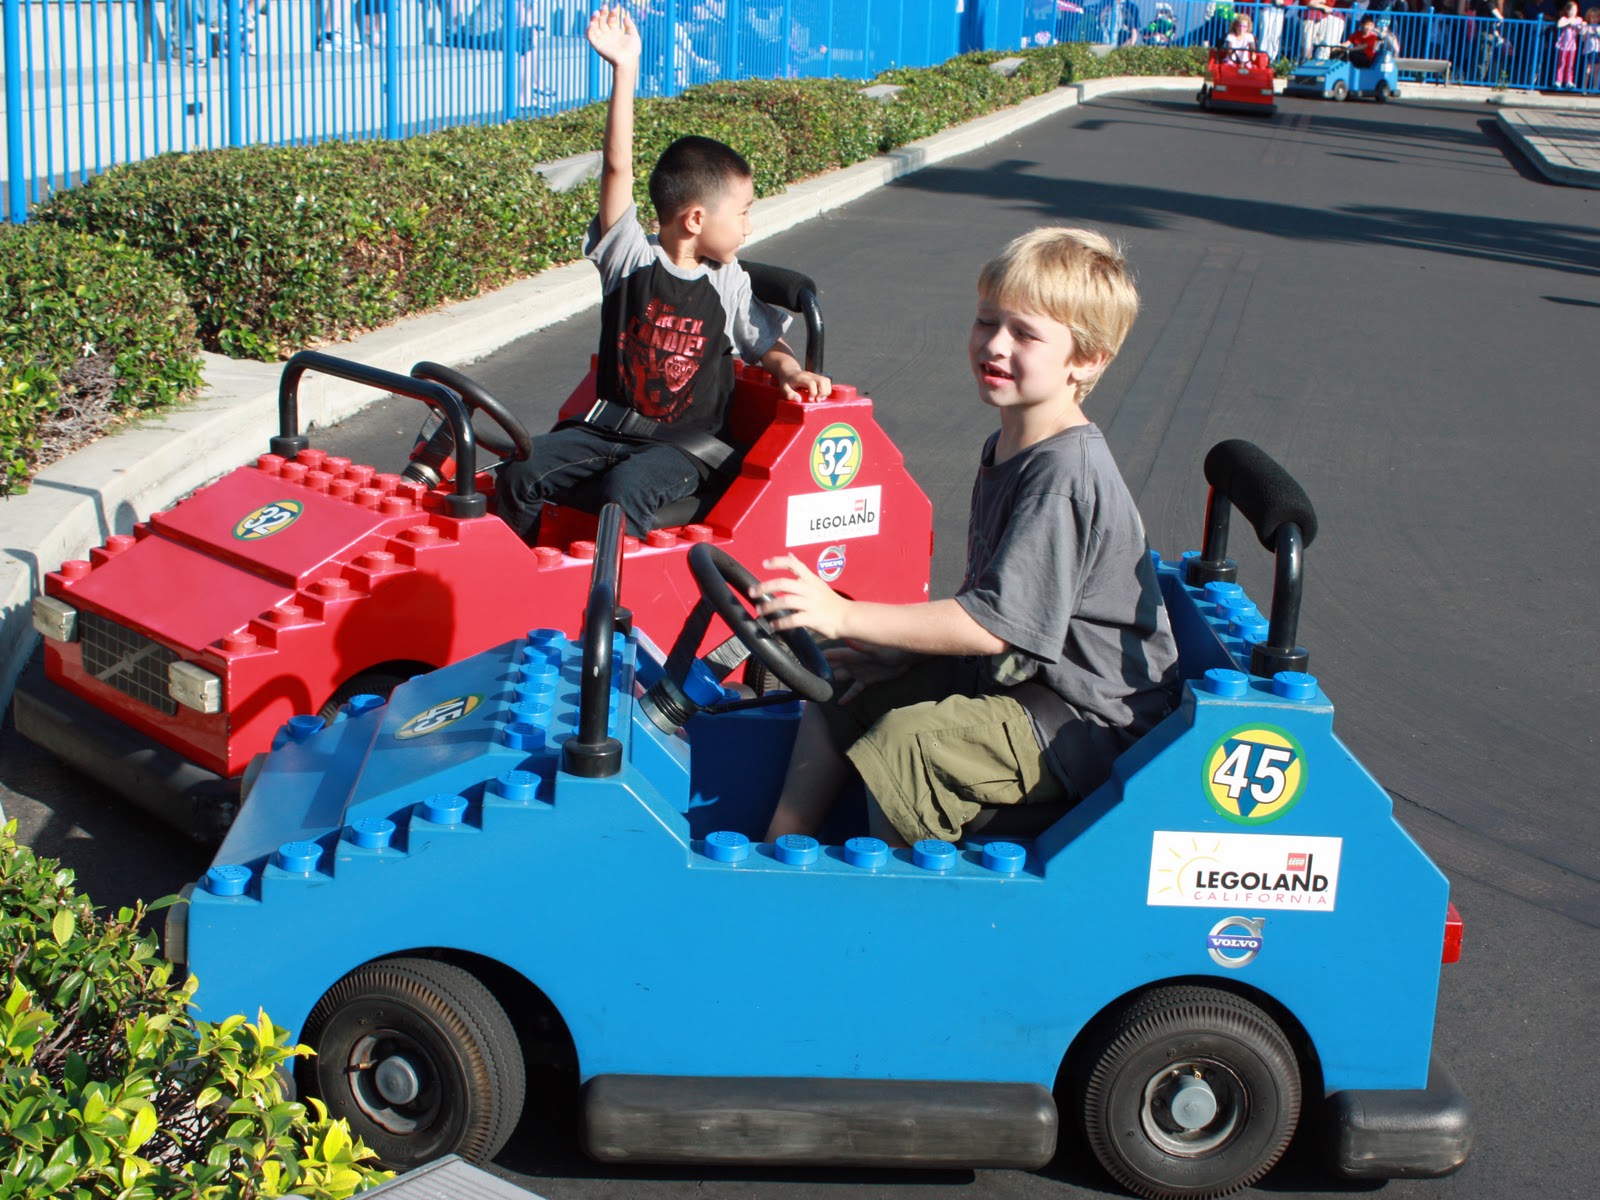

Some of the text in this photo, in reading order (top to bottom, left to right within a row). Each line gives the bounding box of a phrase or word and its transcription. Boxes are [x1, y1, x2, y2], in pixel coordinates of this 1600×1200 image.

[818, 438, 853, 477] 32
[243, 506, 291, 535] 32
[810, 498, 875, 531] LEGOLAND
[819, 560, 844, 569] VOLVO
[413, 700, 465, 733] 45
[1212, 742, 1293, 804] 45
[1195, 853, 1329, 893] LEGOLAND
[1288, 857, 1305, 867] LEGO
[1194, 891, 1328, 905] CALIFORNIA
[1211, 937, 1259, 948] VOLVO
